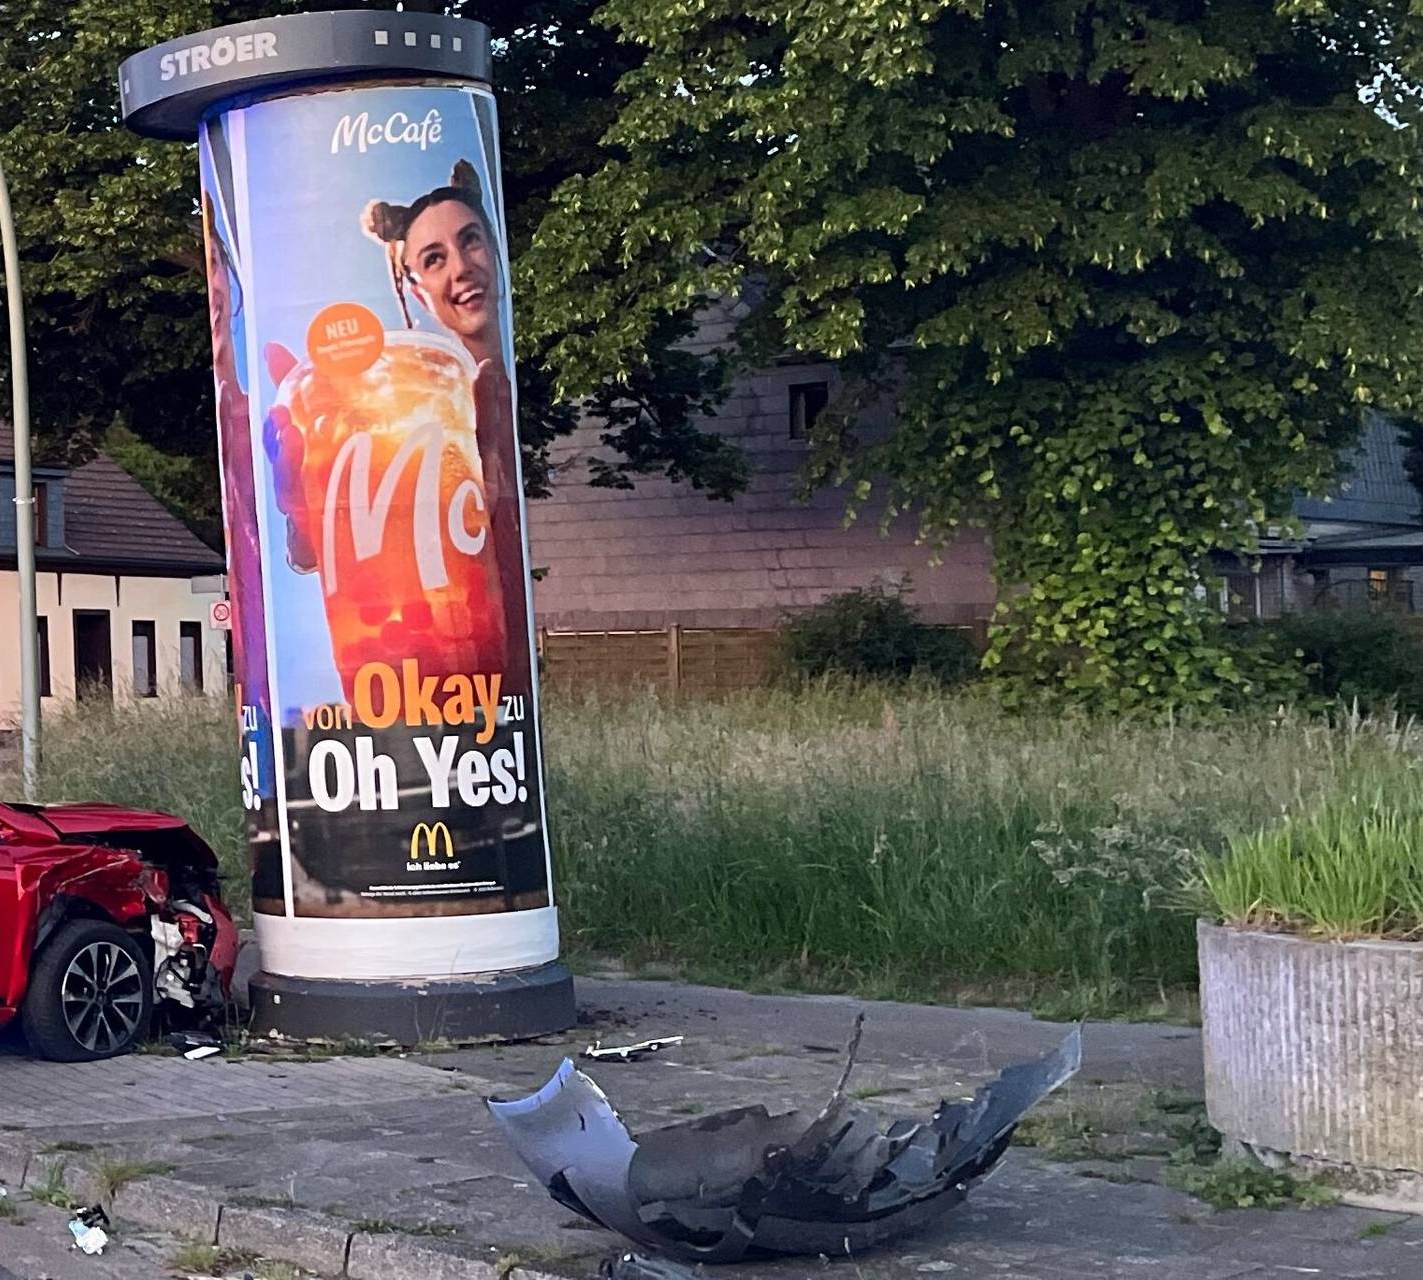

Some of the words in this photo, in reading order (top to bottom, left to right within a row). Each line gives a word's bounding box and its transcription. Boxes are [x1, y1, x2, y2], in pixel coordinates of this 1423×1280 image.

[160, 32, 278, 81] STRÖER
[331, 109, 442, 154] McCafé
[325, 317, 359, 340] NEU
[242, 705, 258, 732] zu
[303, 703, 353, 730] von
[354, 658, 502, 744] Okay
[503, 695, 525, 721] zu
[309, 736, 399, 812] Oh
[413, 731, 528, 808] Yes!
